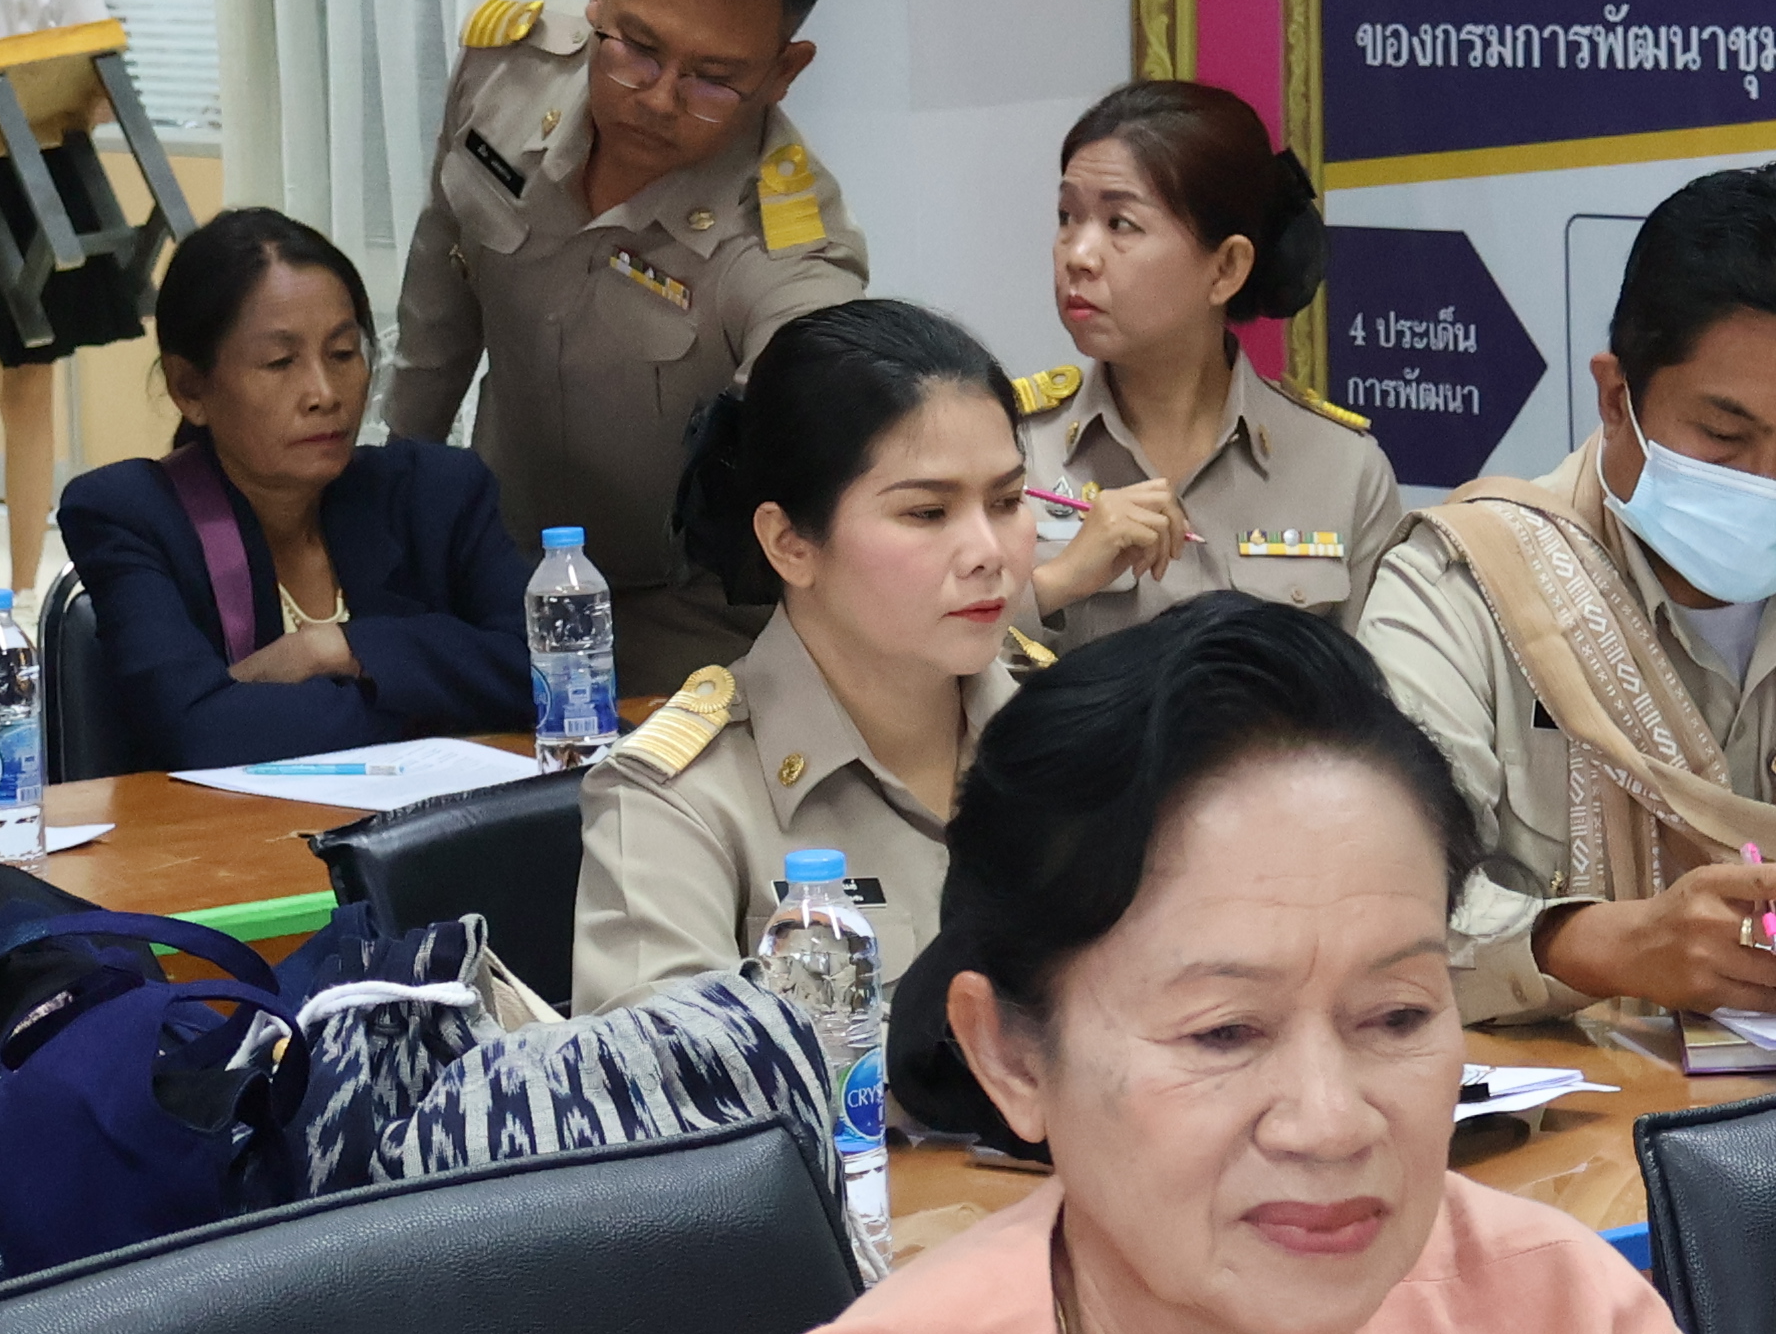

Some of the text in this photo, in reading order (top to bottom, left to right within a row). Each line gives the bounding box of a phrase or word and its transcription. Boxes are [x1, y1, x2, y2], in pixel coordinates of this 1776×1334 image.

[1349, 305, 1478, 353] 4 ประเด็น
[1347, 367, 1480, 416] การพัฒนา
